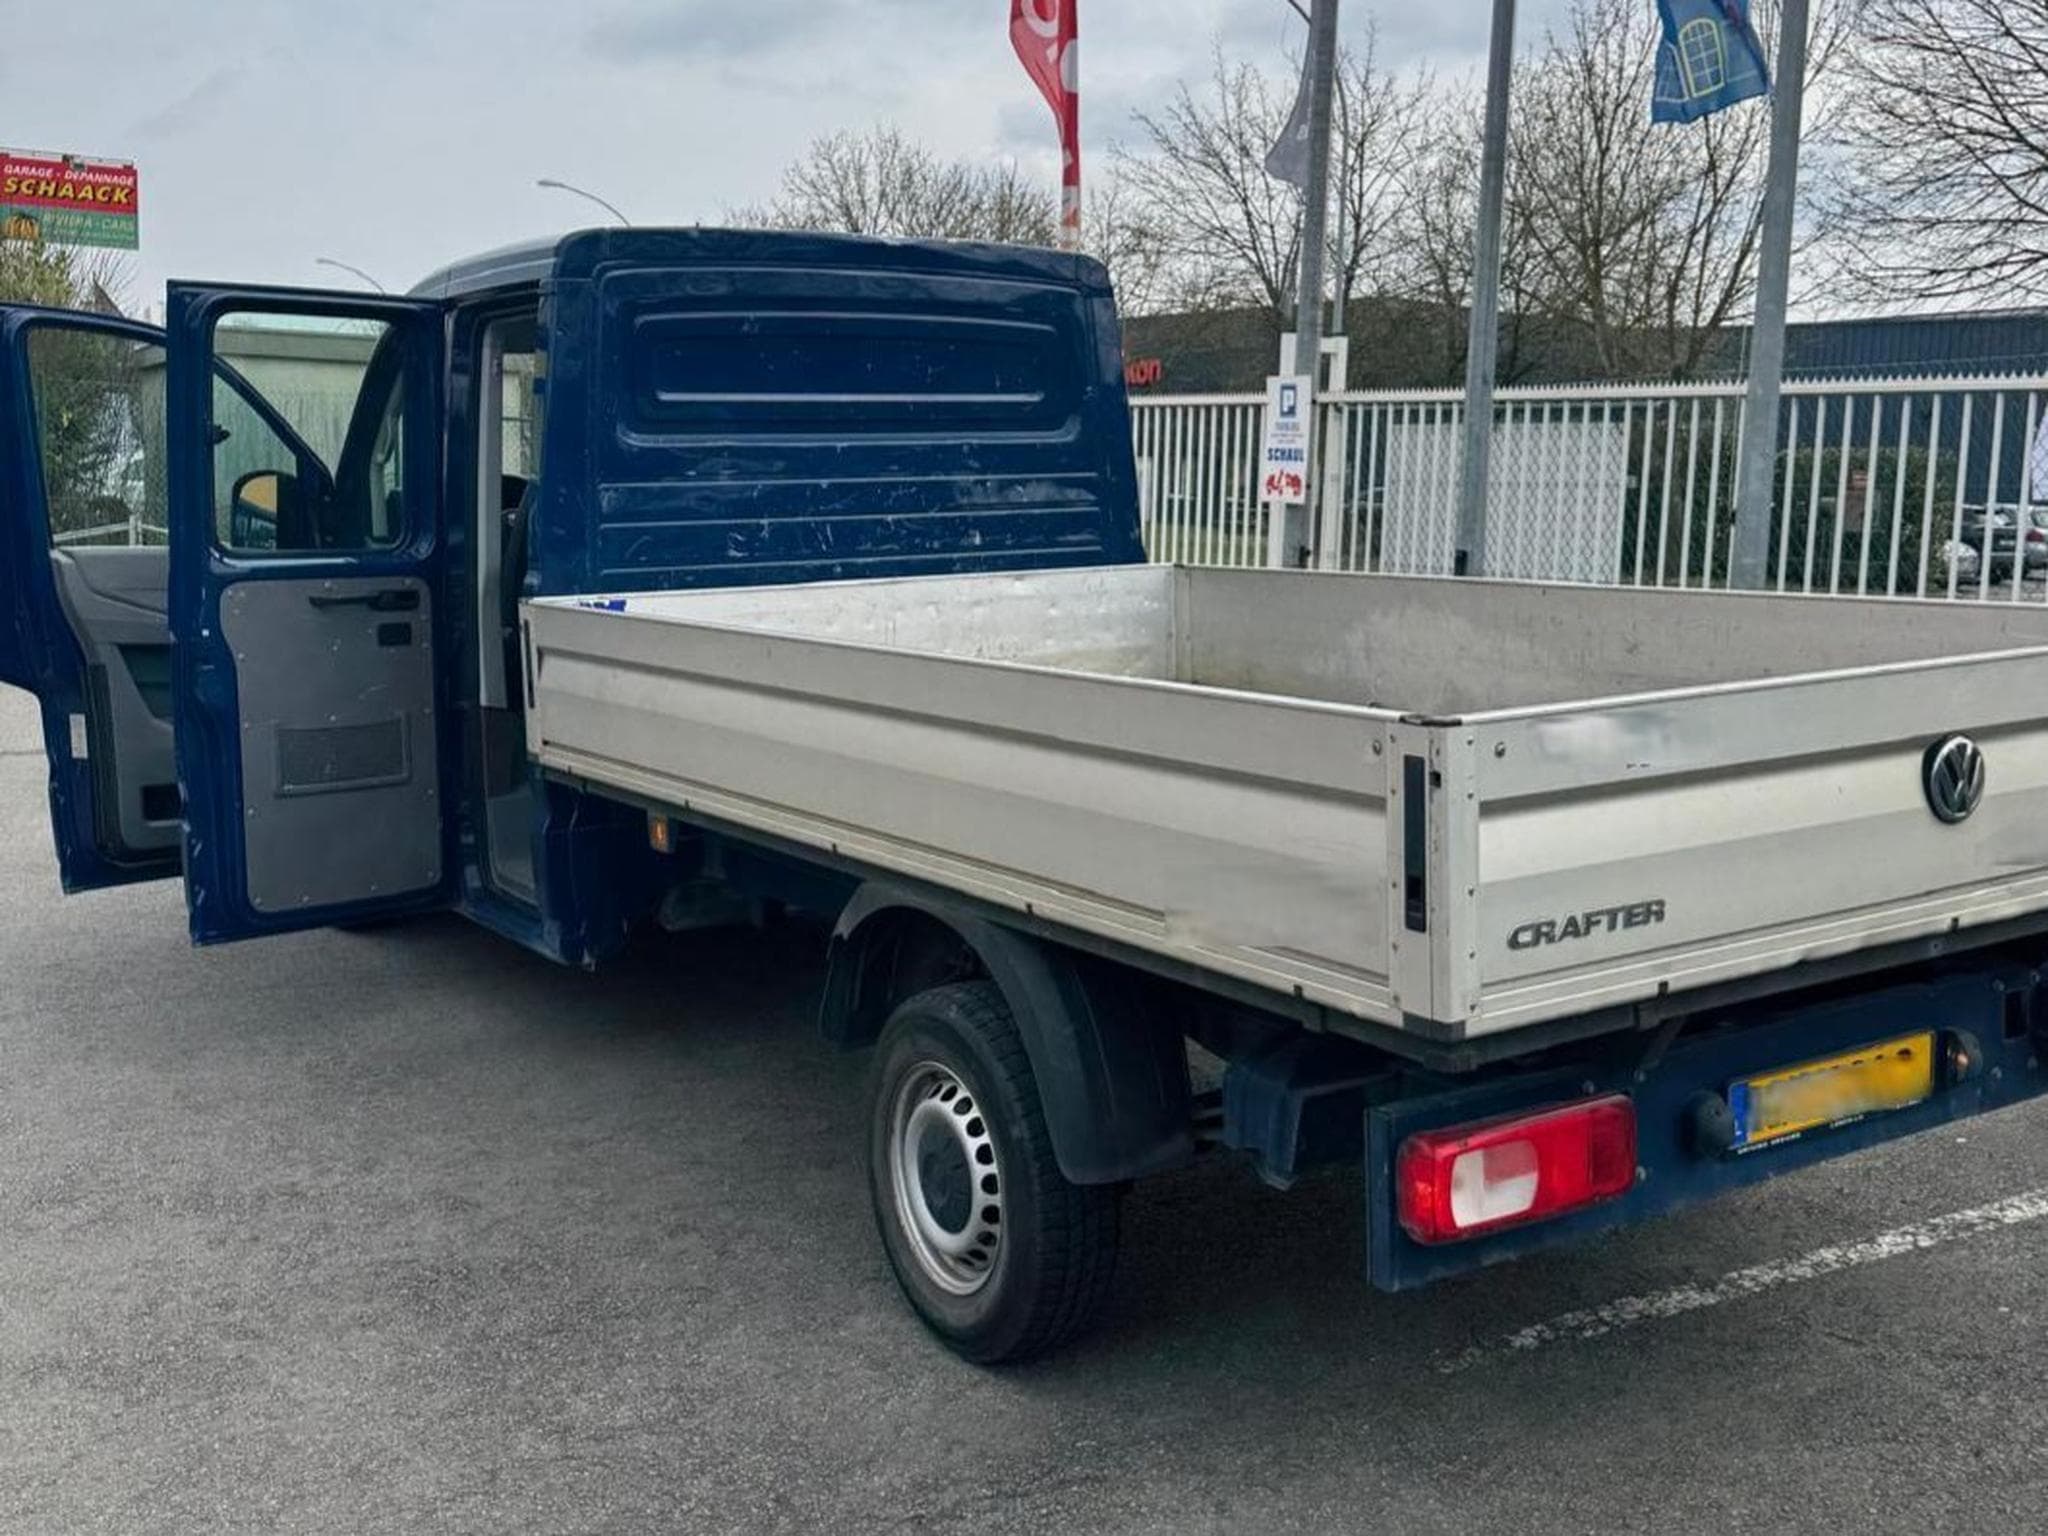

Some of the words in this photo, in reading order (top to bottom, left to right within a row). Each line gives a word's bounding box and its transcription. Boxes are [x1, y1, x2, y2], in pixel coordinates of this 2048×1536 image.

[4, 164, 54, 178] GARAGE
[4, 177, 130, 203] SCHAACK
[1507, 899, 1666, 950] CRAFTER
